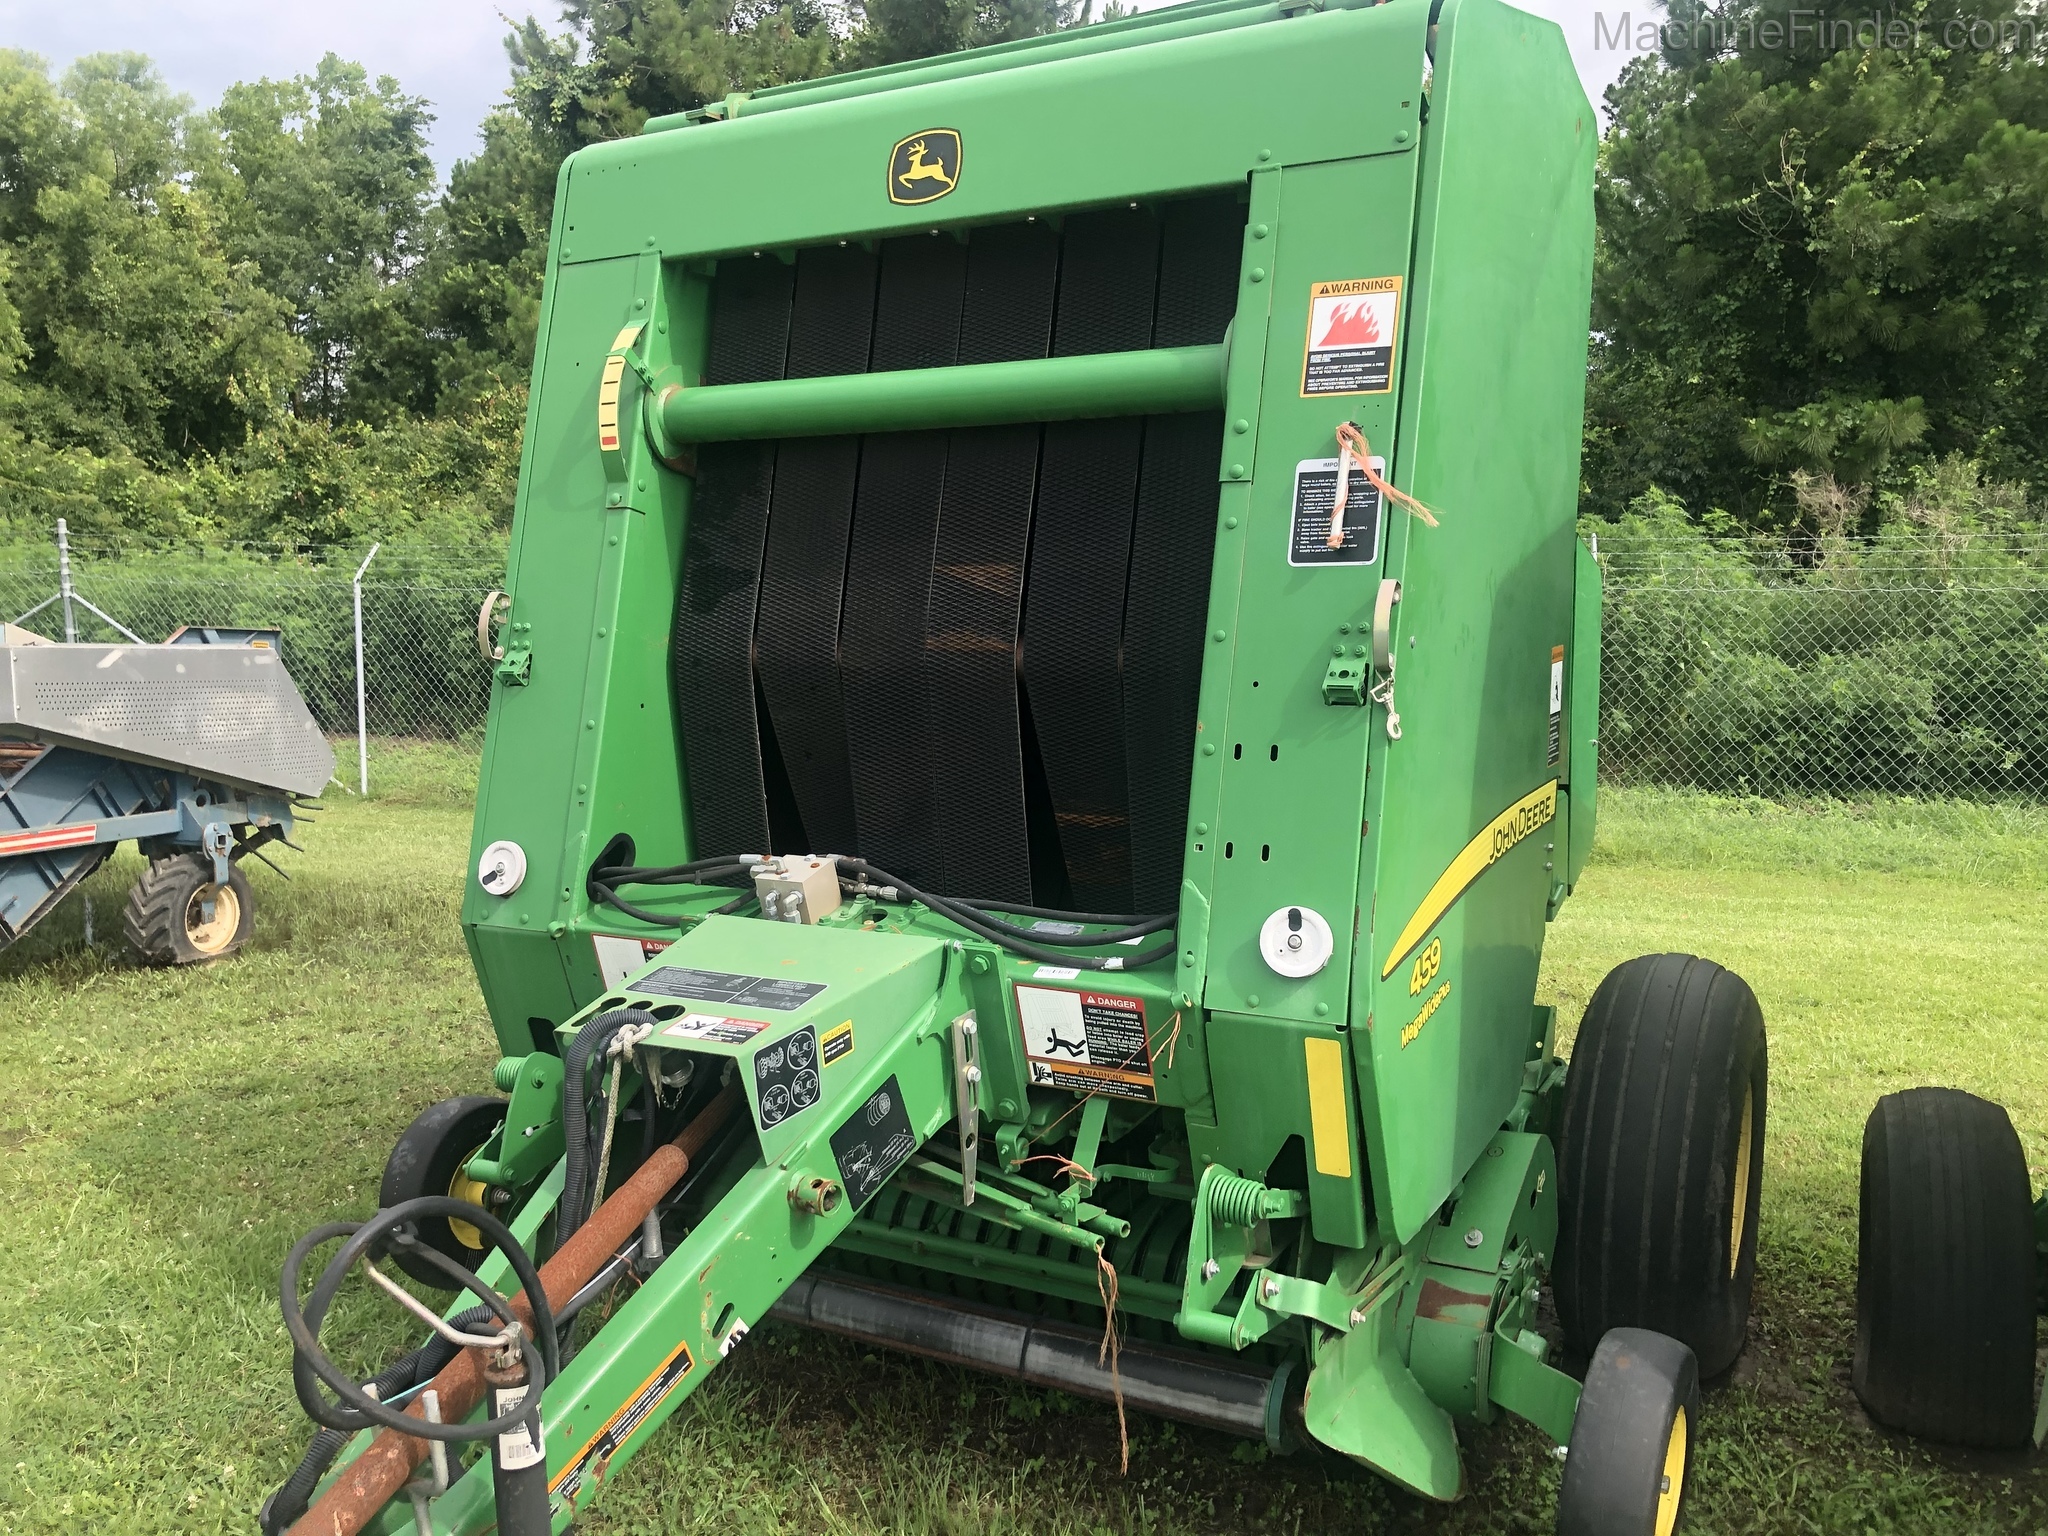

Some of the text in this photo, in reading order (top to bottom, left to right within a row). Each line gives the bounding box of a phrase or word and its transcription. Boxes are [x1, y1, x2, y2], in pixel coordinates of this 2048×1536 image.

[1331, 279, 1393, 293] WARNING
[1489, 795, 1552, 861] JOHN DEERE
[1409, 936, 1441, 998] 459
[1097, 997, 1137, 1009] DANGER
[1085, 1070, 1125, 1080] WARNING
[592, 1408, 625, 1443] WARNING
